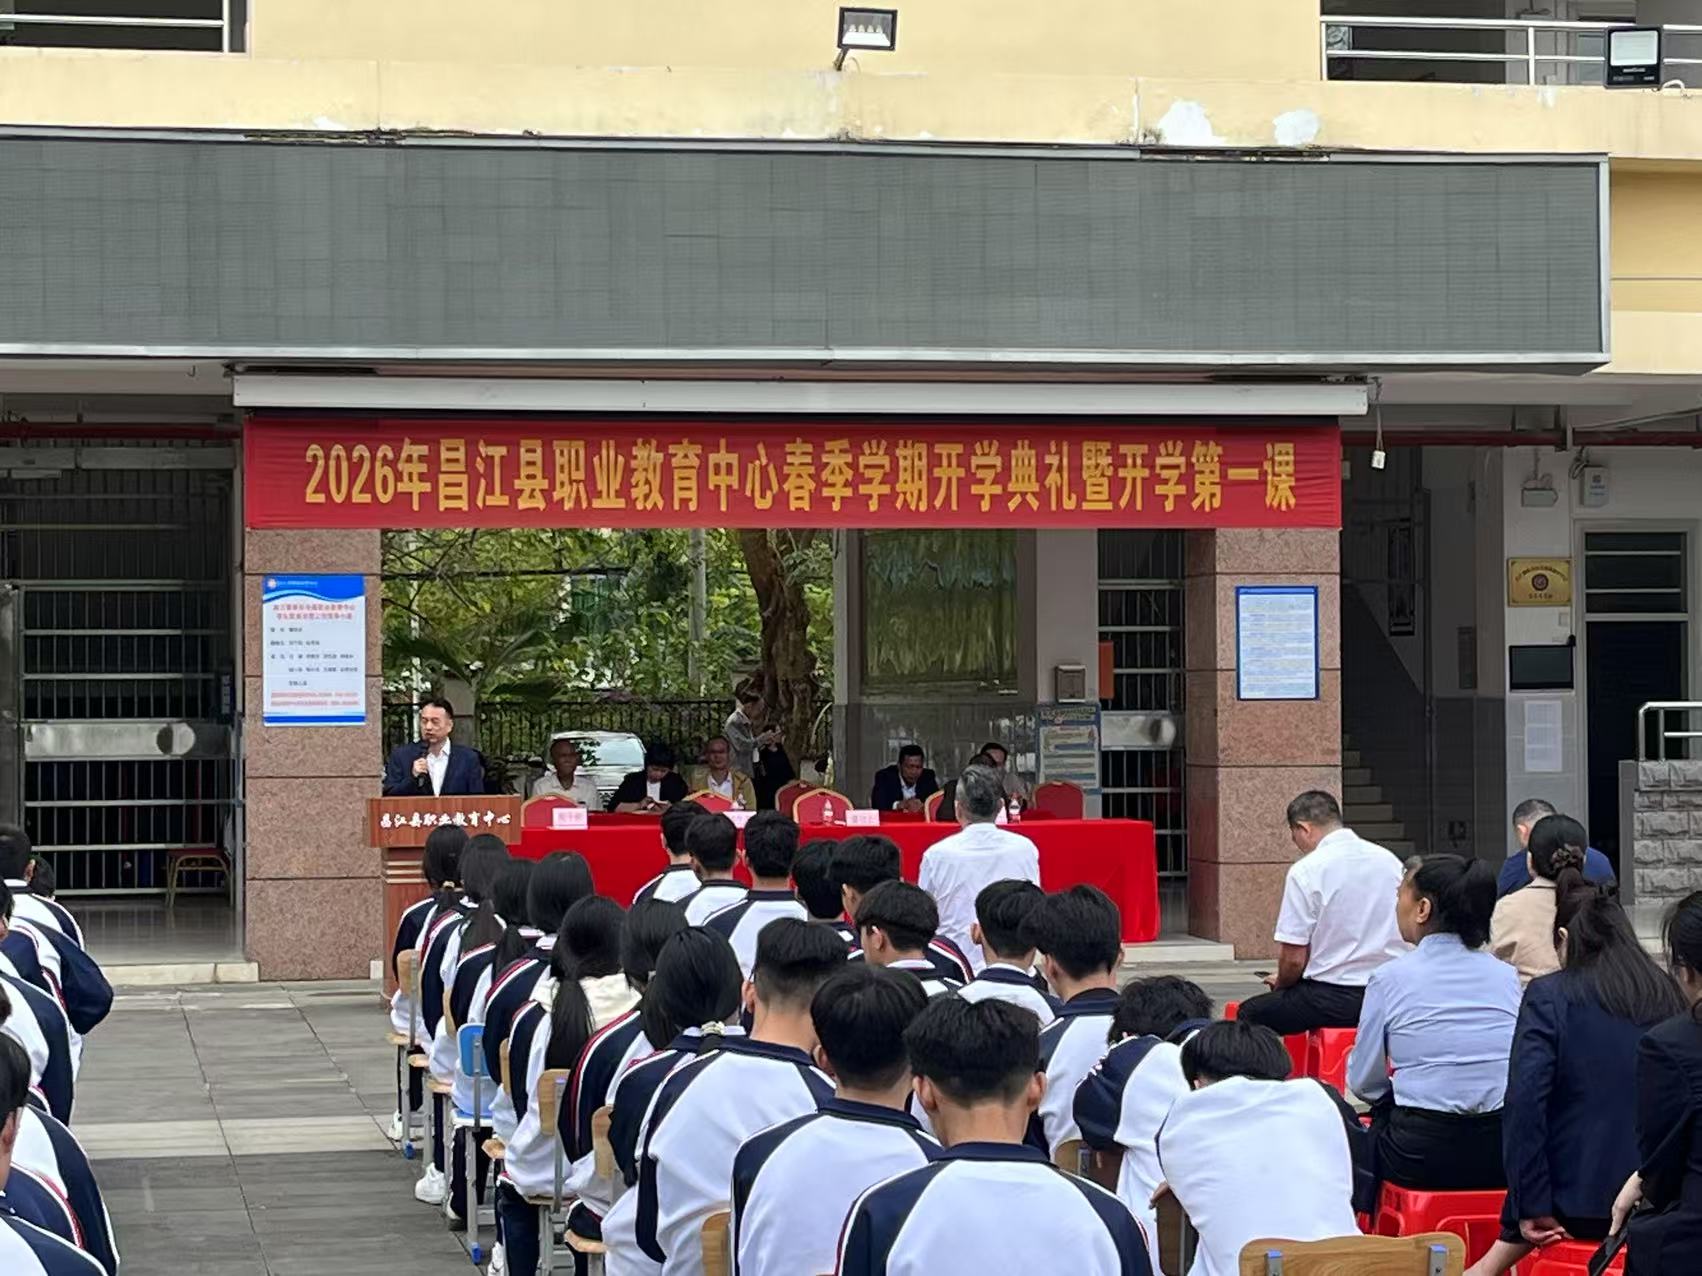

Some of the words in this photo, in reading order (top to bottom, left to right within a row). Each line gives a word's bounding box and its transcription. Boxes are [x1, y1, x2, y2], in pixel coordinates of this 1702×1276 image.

[304, 437, 1297, 512] 2026年昌江县职业教育中心春季学期开学典礼暨开学第一课
[380, 810, 512, 828] 昌江县职业教育中心
